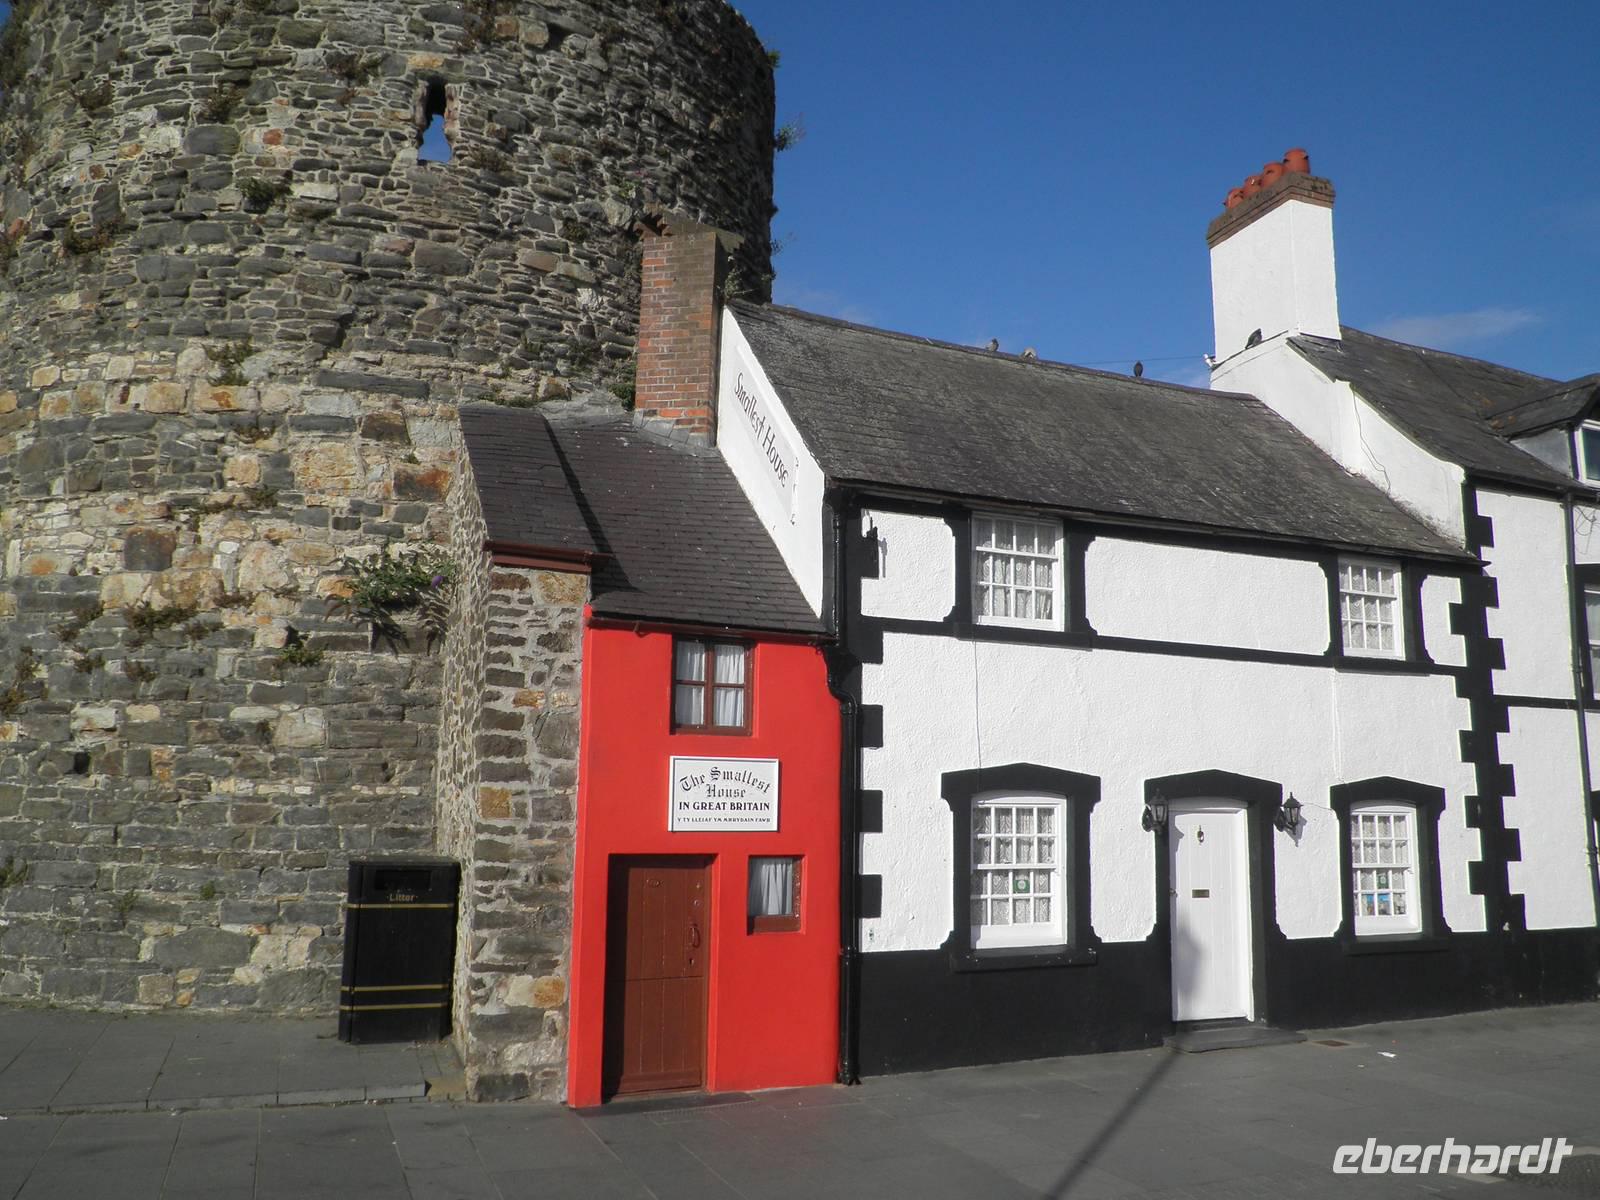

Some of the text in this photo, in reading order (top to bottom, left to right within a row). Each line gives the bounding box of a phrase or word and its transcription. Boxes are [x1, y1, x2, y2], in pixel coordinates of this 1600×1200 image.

[734, 372, 789, 488] Smallest House
[679, 766, 771, 794] The Smallest
[706, 783, 747, 798] House
[679, 801, 770, 811] IN GREAT BRITAIN
